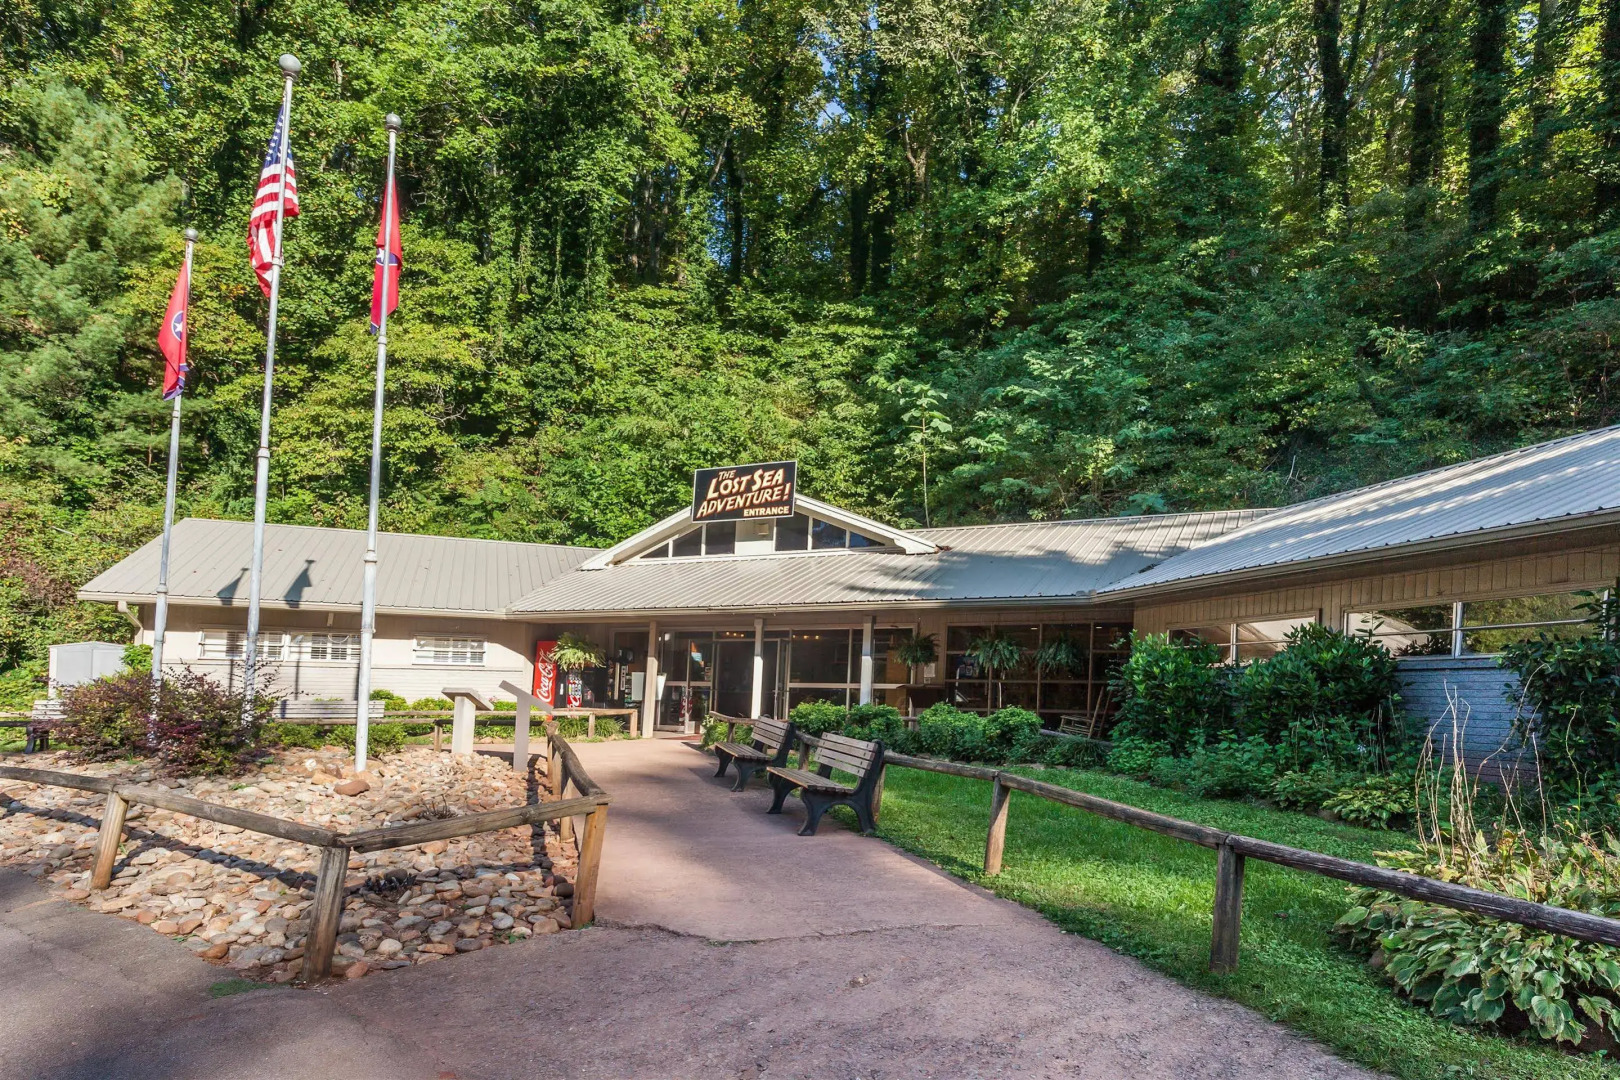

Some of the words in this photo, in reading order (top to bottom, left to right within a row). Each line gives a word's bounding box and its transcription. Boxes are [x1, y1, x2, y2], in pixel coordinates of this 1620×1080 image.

[706, 475, 751, 500] LOST
[751, 469, 785, 492] SEA
[718, 470, 736, 481] THE
[696, 482, 791, 518] ADVENTURE!
[743, 506, 790, 517] ENTRANCE
